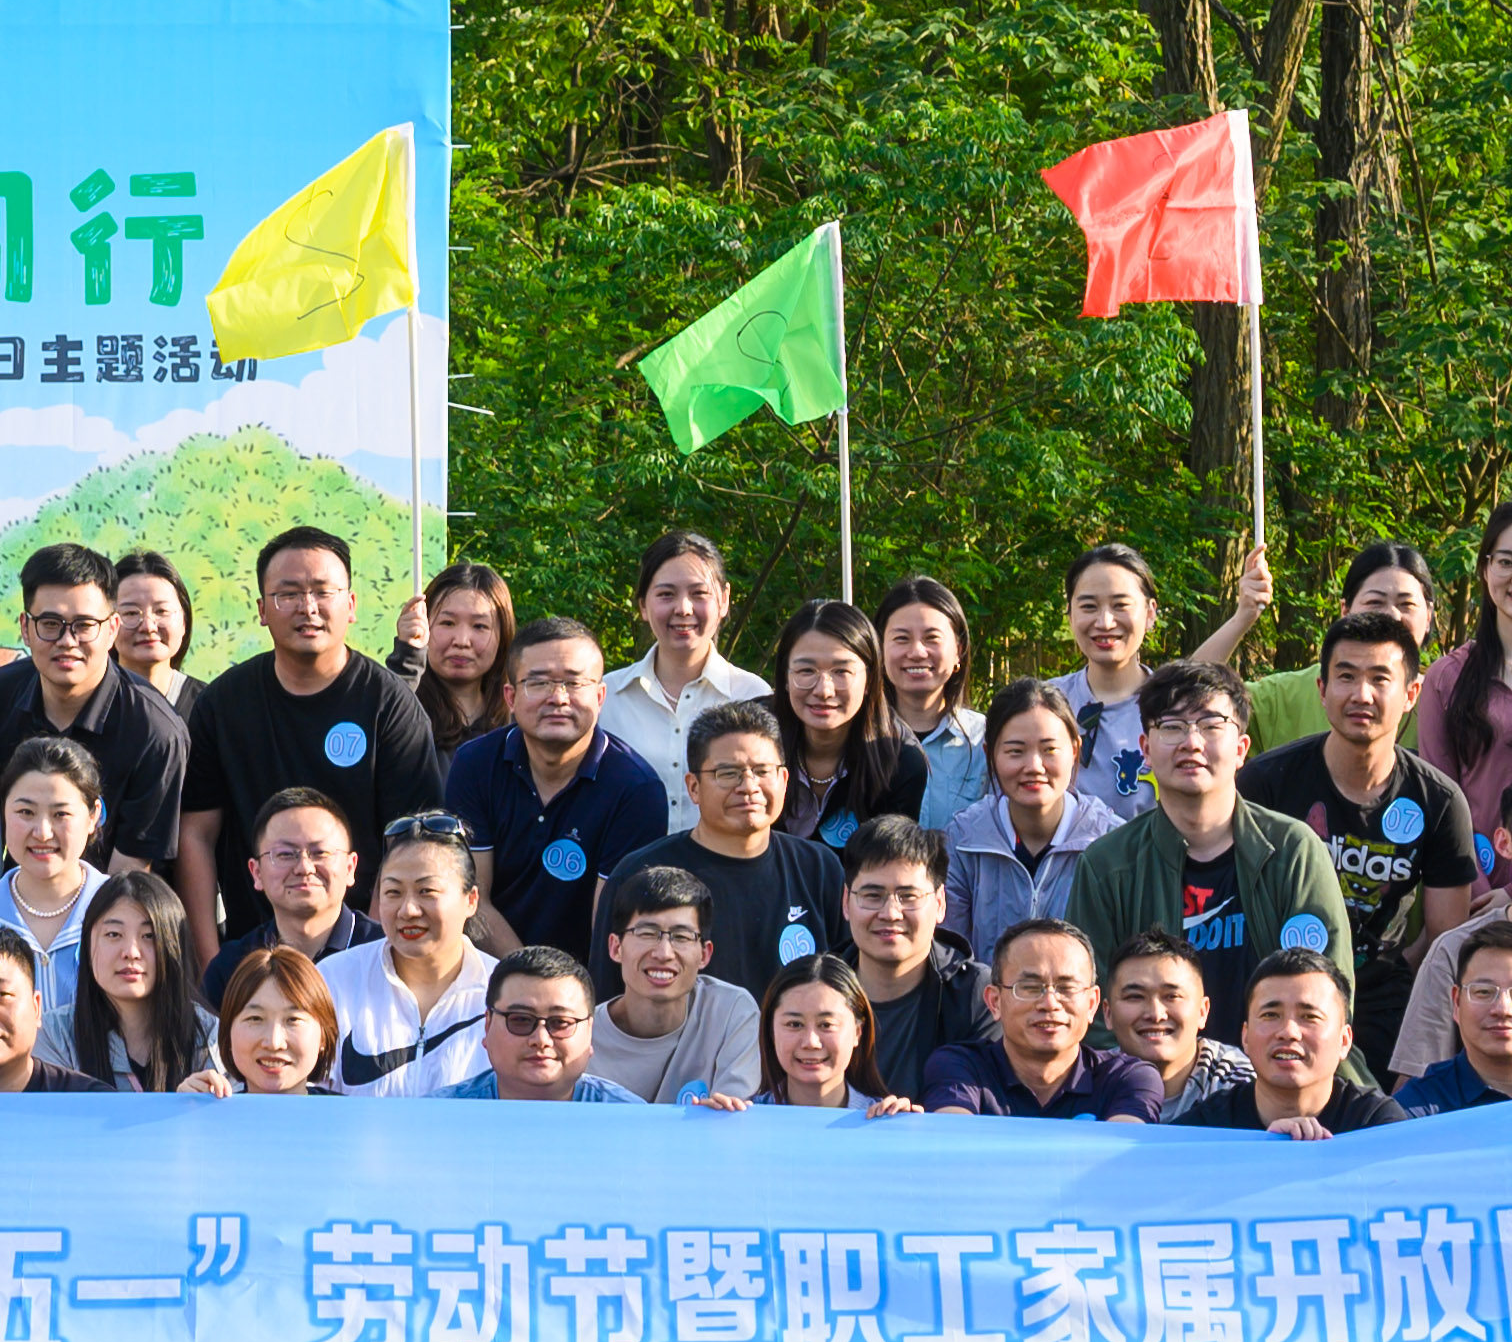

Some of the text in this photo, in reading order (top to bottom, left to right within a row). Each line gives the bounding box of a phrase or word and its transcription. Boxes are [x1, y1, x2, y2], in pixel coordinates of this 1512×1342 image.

[329, 732, 362, 757] 07
[1385, 807, 1420, 834] 07
[546, 846, 581, 873] 06
[782, 930, 810, 963] 05
[1284, 923, 1322, 949] 06
